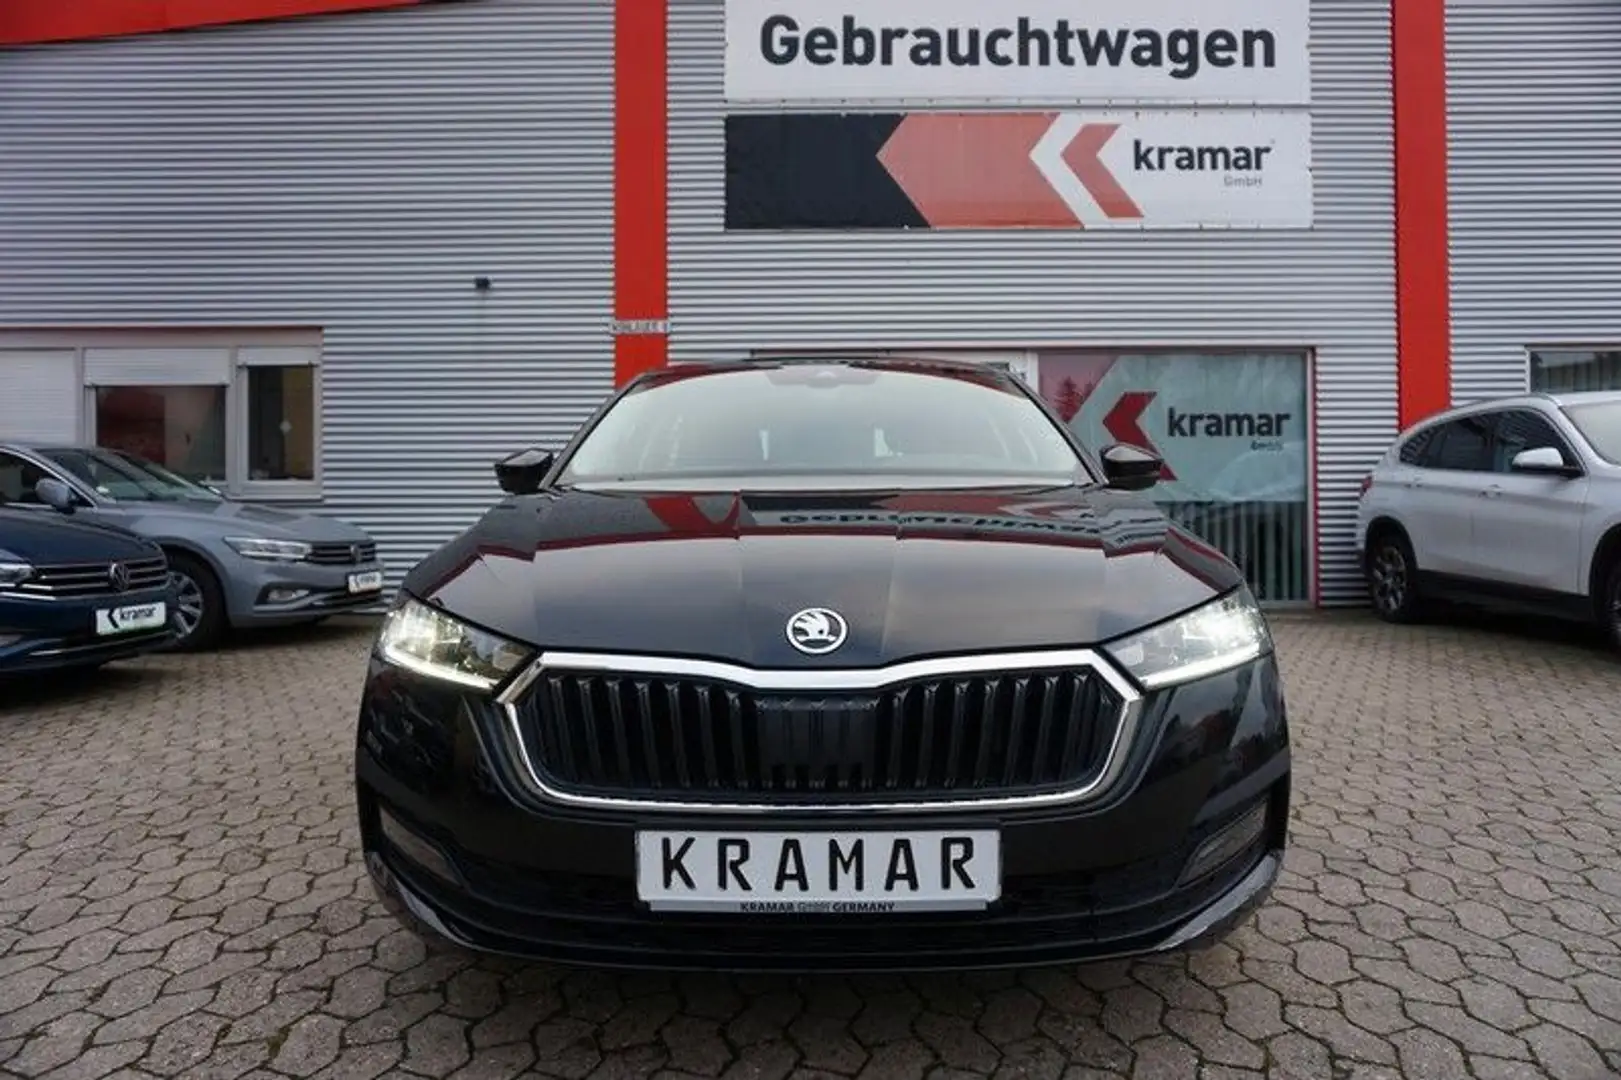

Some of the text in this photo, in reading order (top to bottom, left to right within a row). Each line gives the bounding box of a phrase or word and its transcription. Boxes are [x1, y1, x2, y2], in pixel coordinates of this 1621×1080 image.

[760, 14, 1276, 80] Gebrauchtwagen
[1133, 139, 1272, 171] kramar
[1223, 176, 1263, 187] GmbH
[1167, 407, 1291, 438] kramar
[661, 836, 976, 892] KRAMAR
[740, 901, 793, 912] KRAMAR
[832, 901, 895, 912] GERMANY
